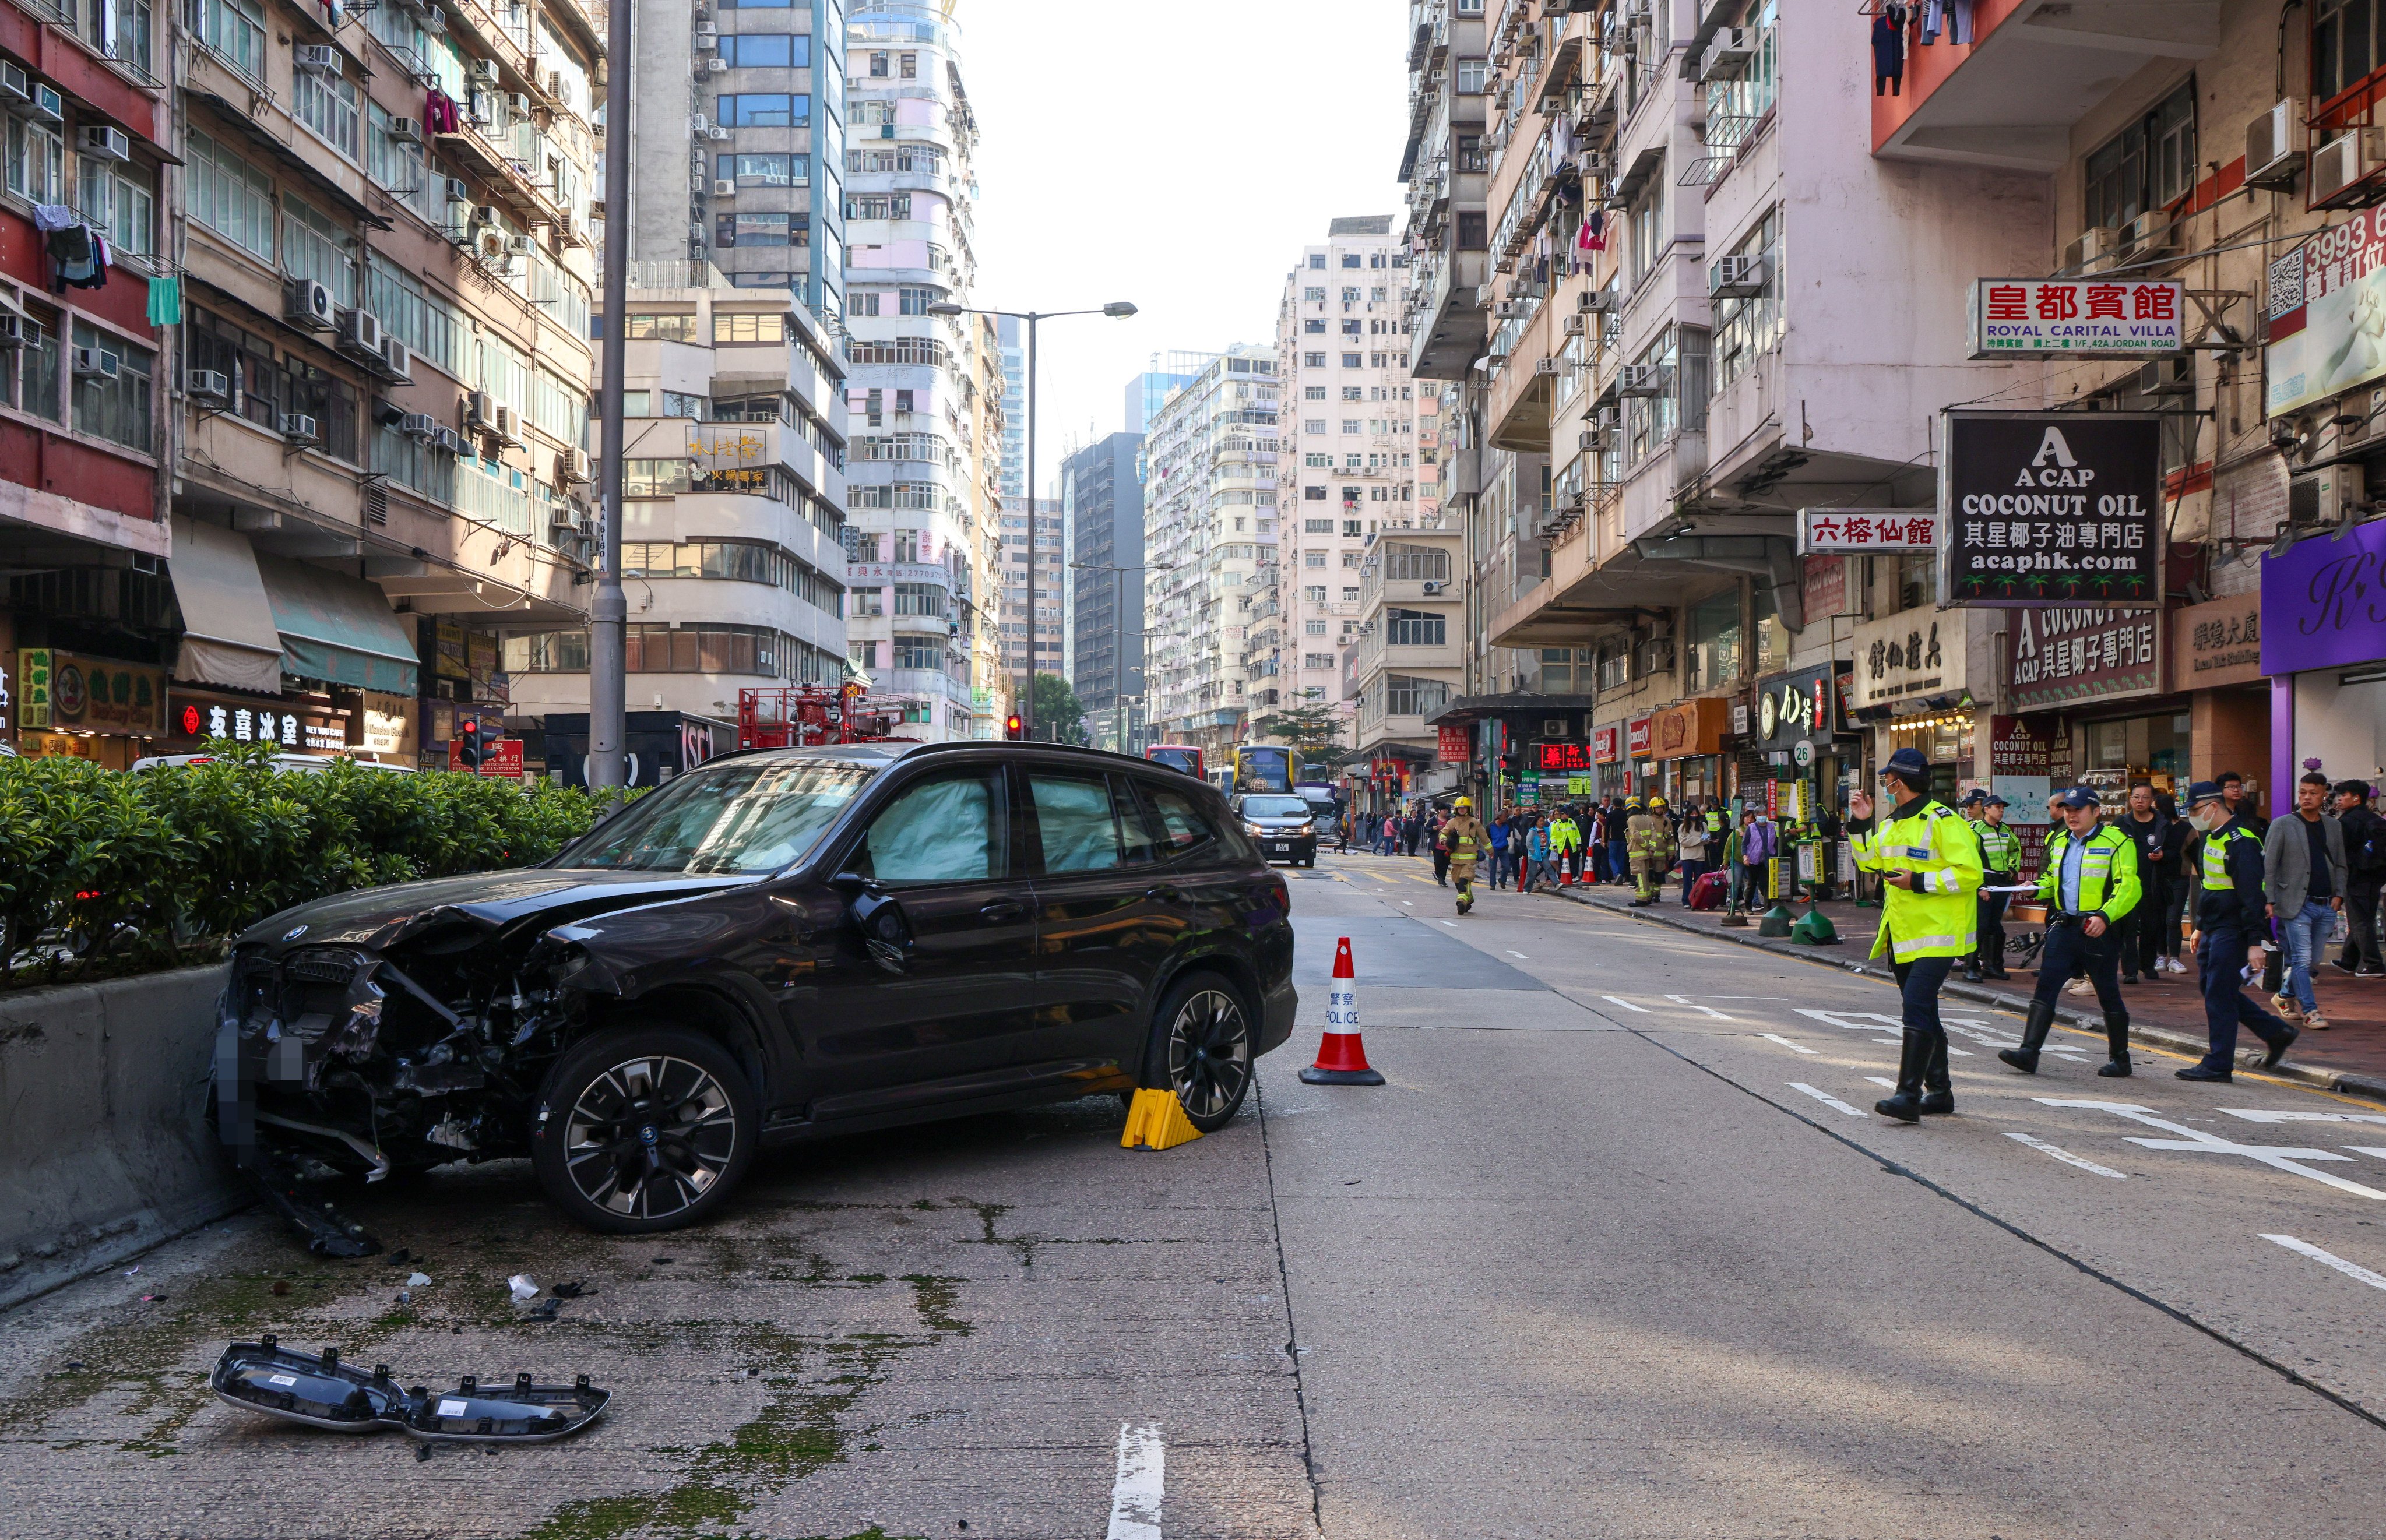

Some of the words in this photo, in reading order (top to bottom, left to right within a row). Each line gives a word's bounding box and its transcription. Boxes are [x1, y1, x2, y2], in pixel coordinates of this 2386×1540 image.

[2306, 215, 2366, 273] 3993
[2305, 240, 2385, 304] 尊貴訂位
[1987, 284, 2176, 321] 皇都賓館
[1987, 325, 2042, 336] ROYAL
[2051, 325, 2121, 336] CARITAL
[2130, 325, 2176, 336] VILLA
[1987, 339, 2023, 348] 持牌賓館
[2033, 339, 2070, 348] 請上二樓
[2152, 340, 2176, 348] ROAD
[2032, 426, 2078, 467] A
[712, 470, 763, 482] 火鍋專家
[2015, 468, 2036, 487] A
[2040, 468, 2095, 487] CAP
[601, 505, 606, 521] AA
[1962, 494, 2087, 516] COCONUT
[2098, 494, 2146, 516] OIL
[1813, 517, 1934, 545] 六榕仙館
[1965, 521, 2144, 549] 其星椰子油專門店
[1971, 551, 2137, 573] acaphk.com
[2018, 609, 2036, 660] A
[2193, 611, 2260, 651] 聯德大廈
[2043, 623, 2152, 679] 其星椰子專門店
[2227, 649, 2260, 666] Building
[2014, 662, 2022, 685] A
[2022, 659, 2039, 684] CAP
[210, 706, 297, 745] 友喜冰室
[305, 725, 318, 734] HEY
[318, 727, 329, 735] YOU
[330, 728, 344, 737] CAFE
[2014, 720, 2026, 733] A
[2057, 716, 2065, 738] A
[1631, 731, 1642, 743] CIRCLE
[2058, 738, 2068, 749] CAP
[1796, 747, 1808, 760] 26
[1994, 741, 2030, 752] COCONUT
[2033, 741, 2046, 752] OIL
[1994, 753, 2046, 764] 其星椰子專門店
[1570, 780, 1581, 792] 寄
[1331, 993, 1353, 1006] 警察
[1326, 1011, 1359, 1024] POLICE
